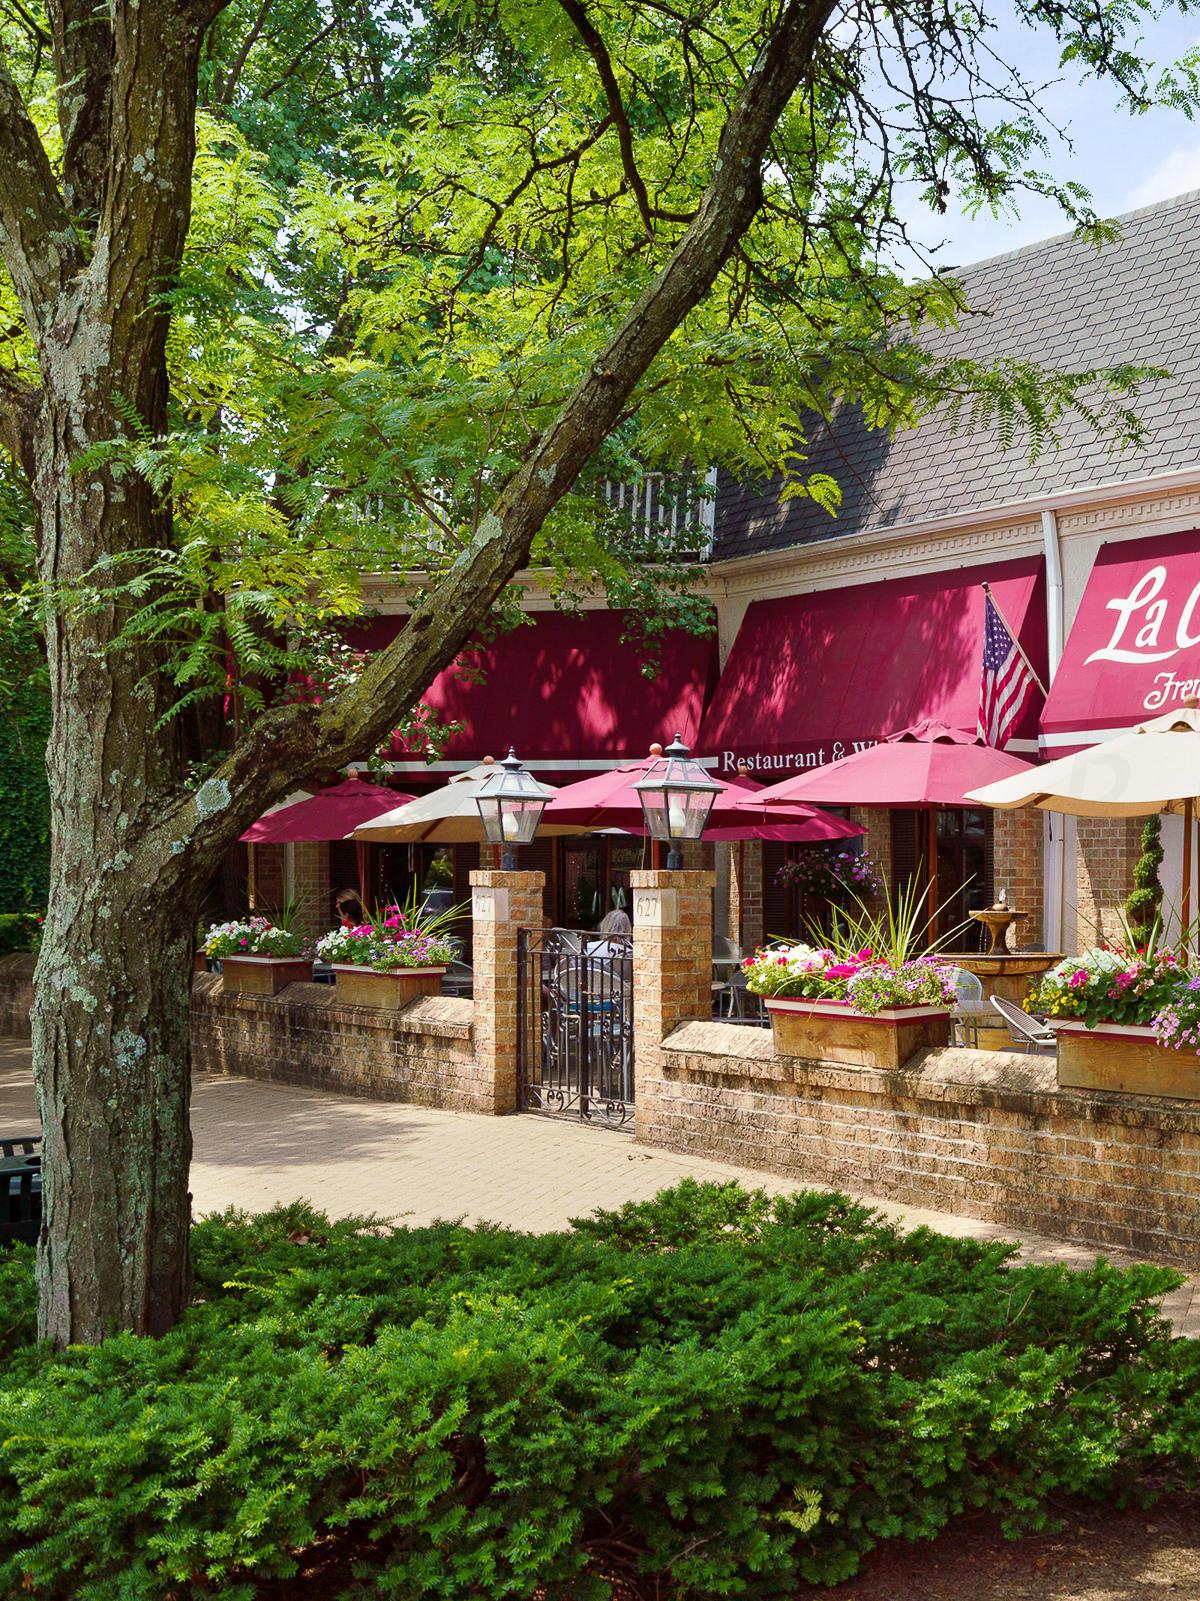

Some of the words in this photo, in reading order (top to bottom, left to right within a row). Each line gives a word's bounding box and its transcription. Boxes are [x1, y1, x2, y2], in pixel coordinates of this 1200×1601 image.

[1083, 565, 1180, 666] La
[722, 748, 825, 772] Restaurant
[832, 741, 845, 763] &
[637, 896, 658, 917] 627
